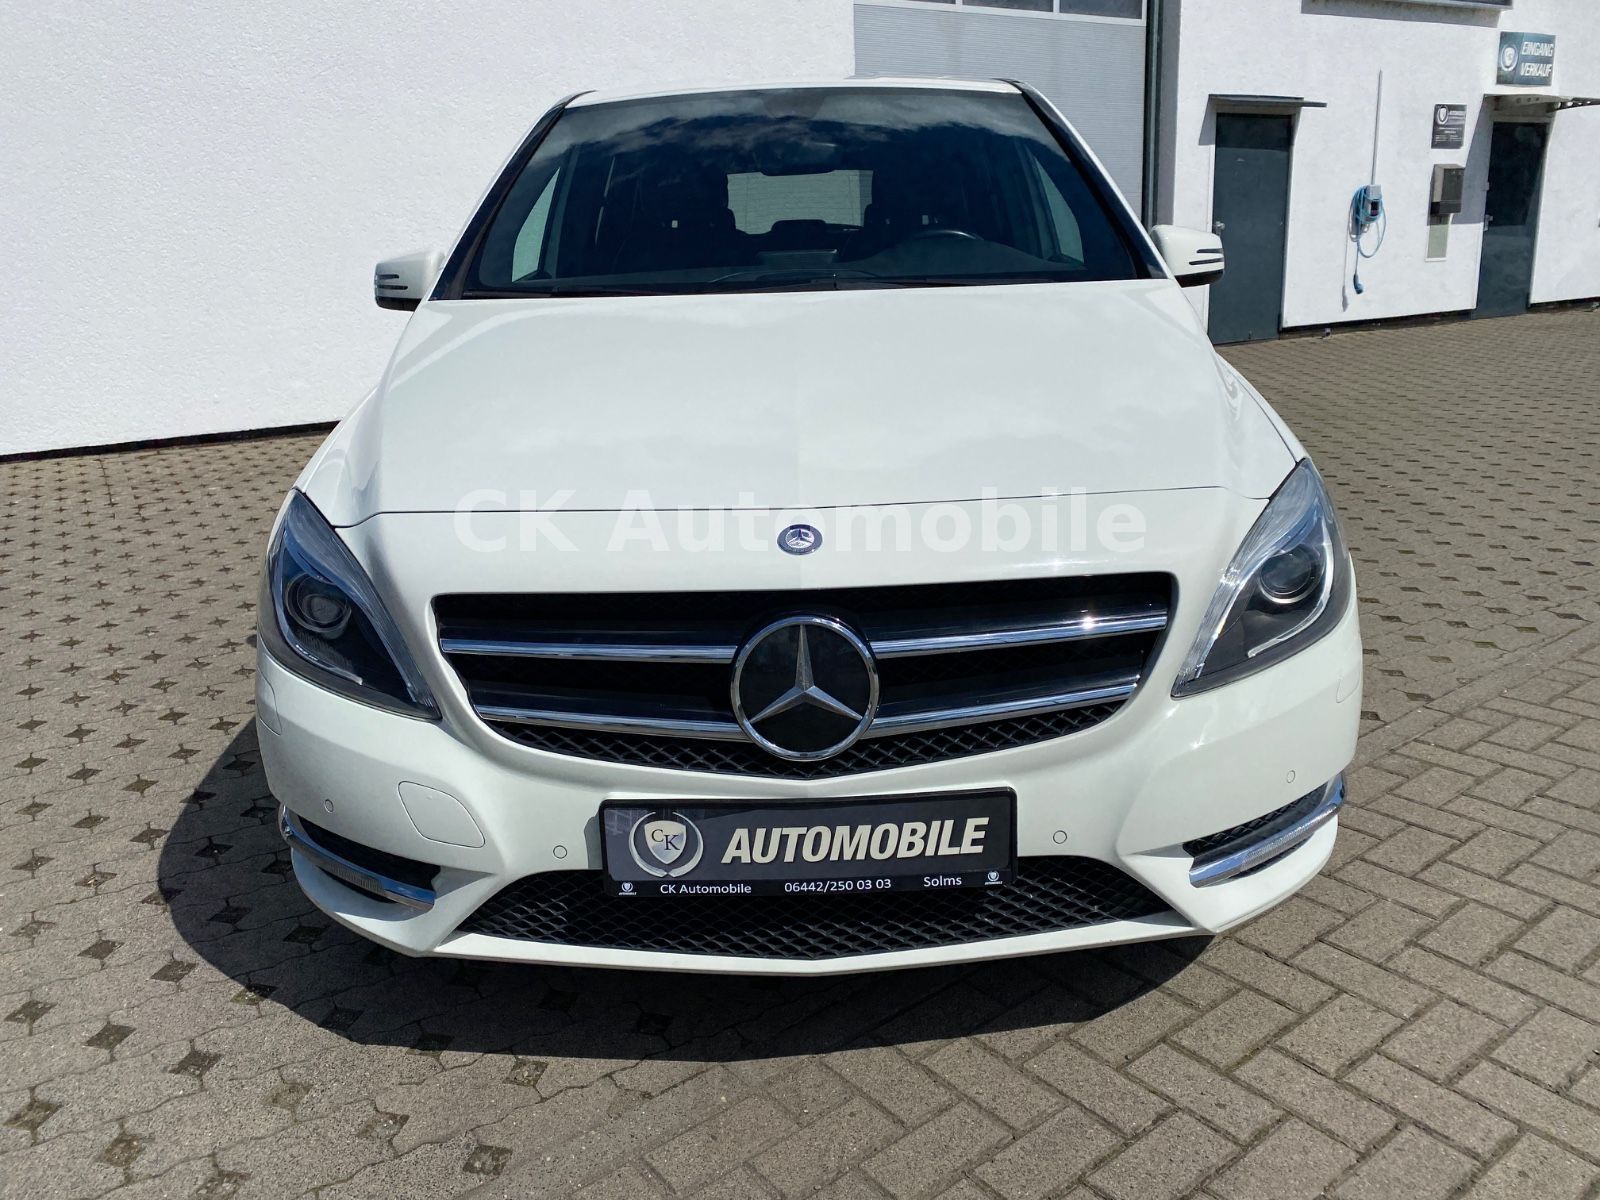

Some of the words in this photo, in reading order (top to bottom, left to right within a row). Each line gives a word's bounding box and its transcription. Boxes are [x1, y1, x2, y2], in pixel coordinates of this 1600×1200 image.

[1521, 41, 1554, 57] EINGANG
[1520, 62, 1552, 77] VERKAUF
[651, 828, 681, 851] CK
[720, 816, 990, 865] AUTOMOBILE
[660, 884, 676, 894] CK
[679, 883, 752, 894] Automobile
[784, 880, 854, 893] 06442/250
[856, 879, 872, 890] 03
[875, 878, 892, 889] 03
[923, 875, 962, 888] Solms
